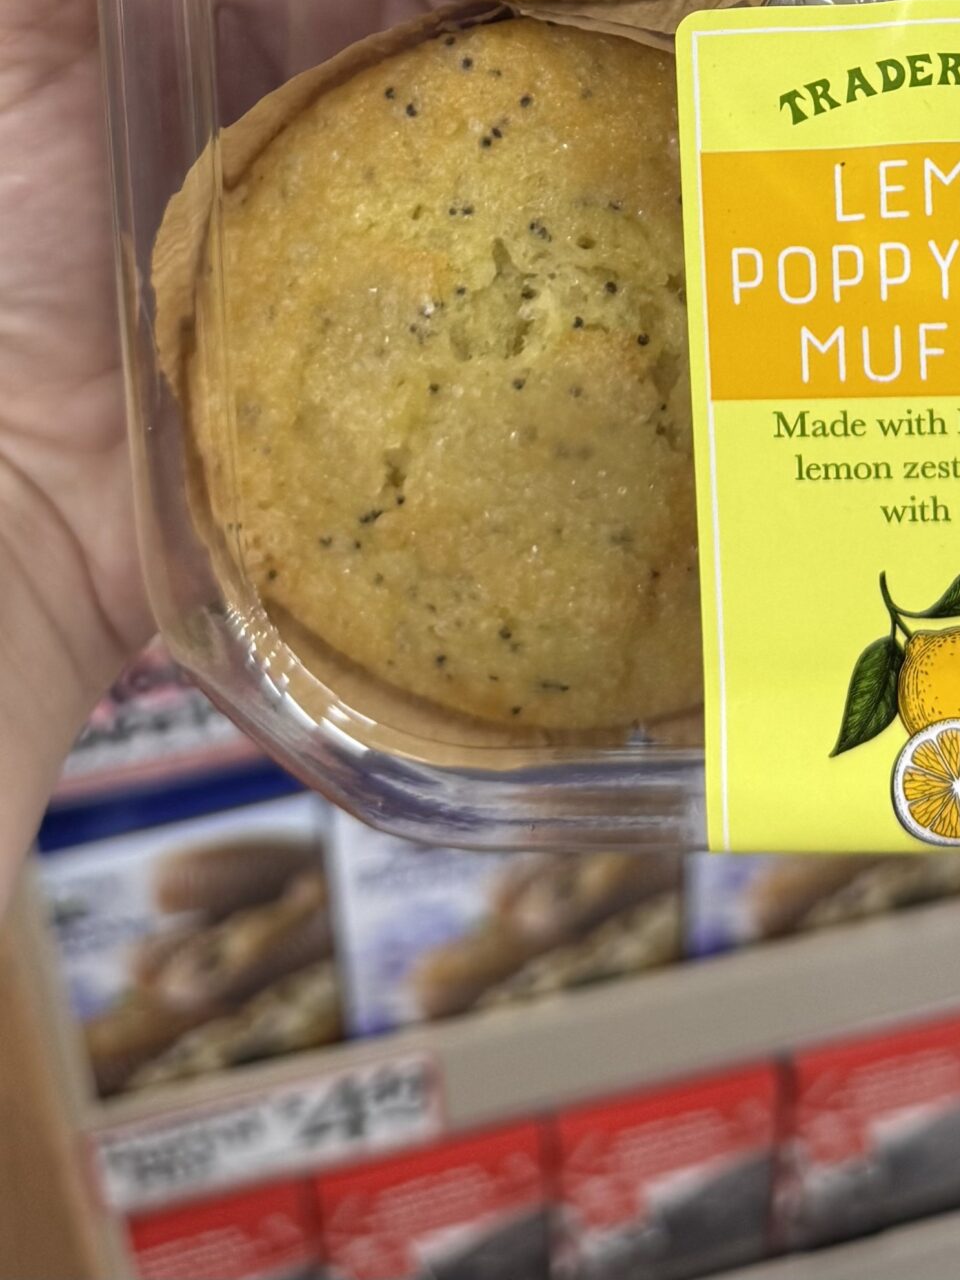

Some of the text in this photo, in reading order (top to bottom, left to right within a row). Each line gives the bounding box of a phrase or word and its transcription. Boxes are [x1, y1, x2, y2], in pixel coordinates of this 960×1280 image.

[730, 238, 960, 306] POPPY
[772, 410, 868, 439] Made
[877, 408, 949, 436] with
[794, 453, 894, 481] lemon
[880, 495, 952, 524] with
